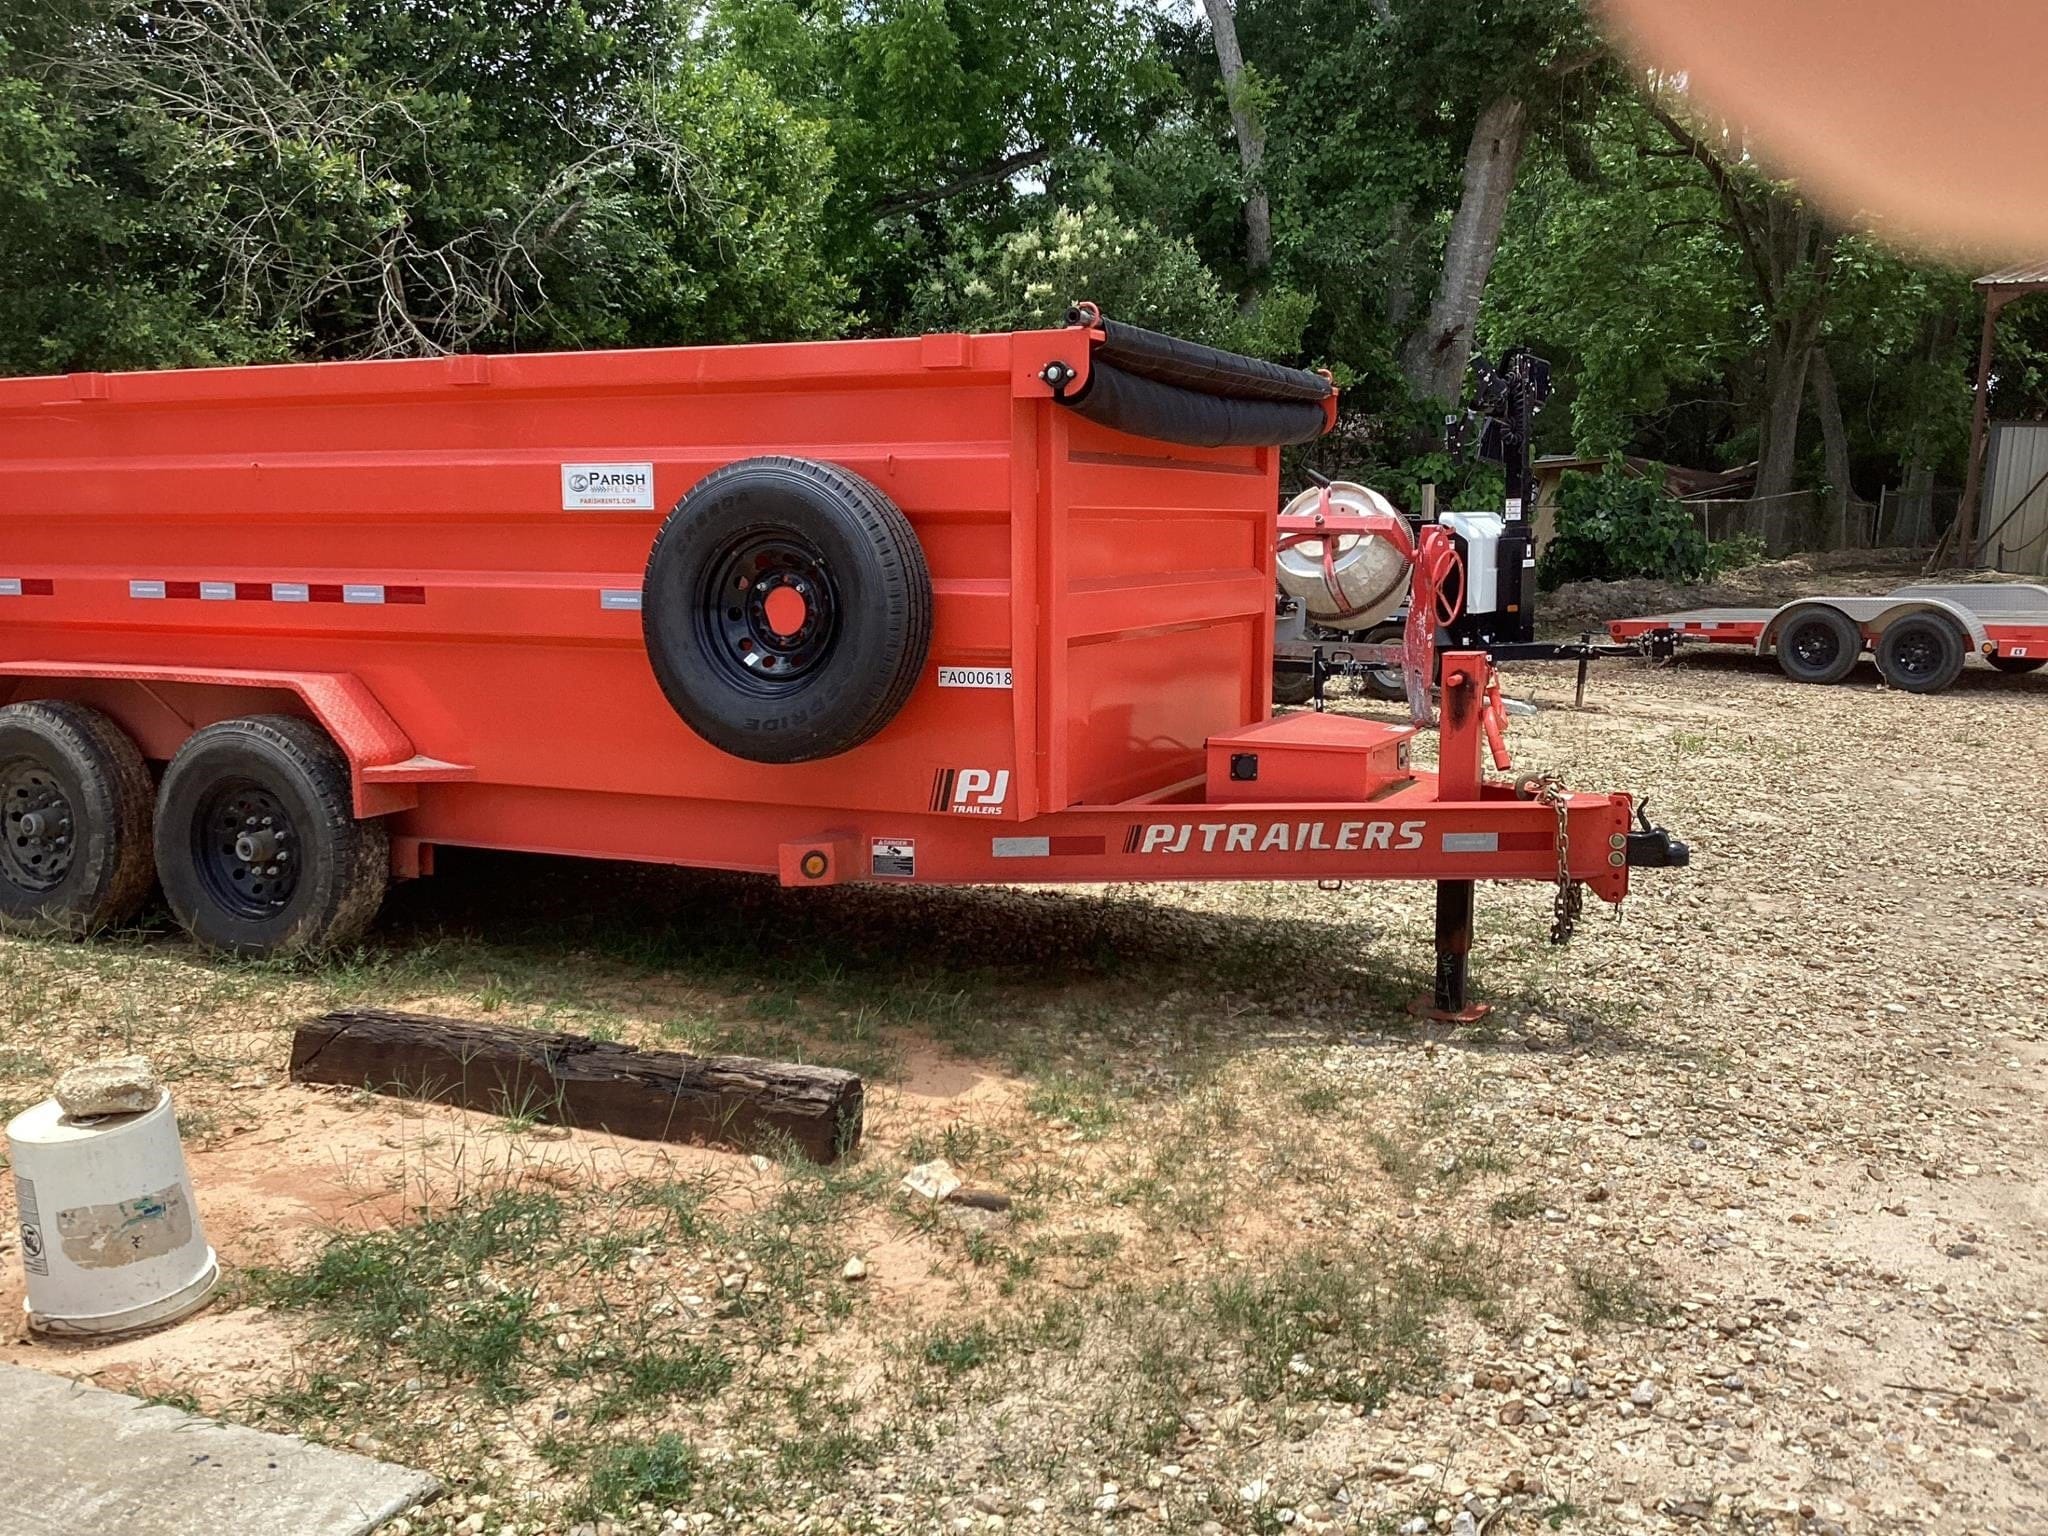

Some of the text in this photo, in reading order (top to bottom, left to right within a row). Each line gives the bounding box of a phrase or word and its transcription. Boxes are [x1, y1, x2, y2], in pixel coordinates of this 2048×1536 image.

[589, 472, 646, 485] PARISH
[607, 485, 646, 493] RENTS
[939, 671, 1012, 685] FA000618
[954, 769, 1010, 804] PJ
[953, 805, 1003, 815] TRAILERS
[1141, 821, 1427, 853] PJ TRAILERS
